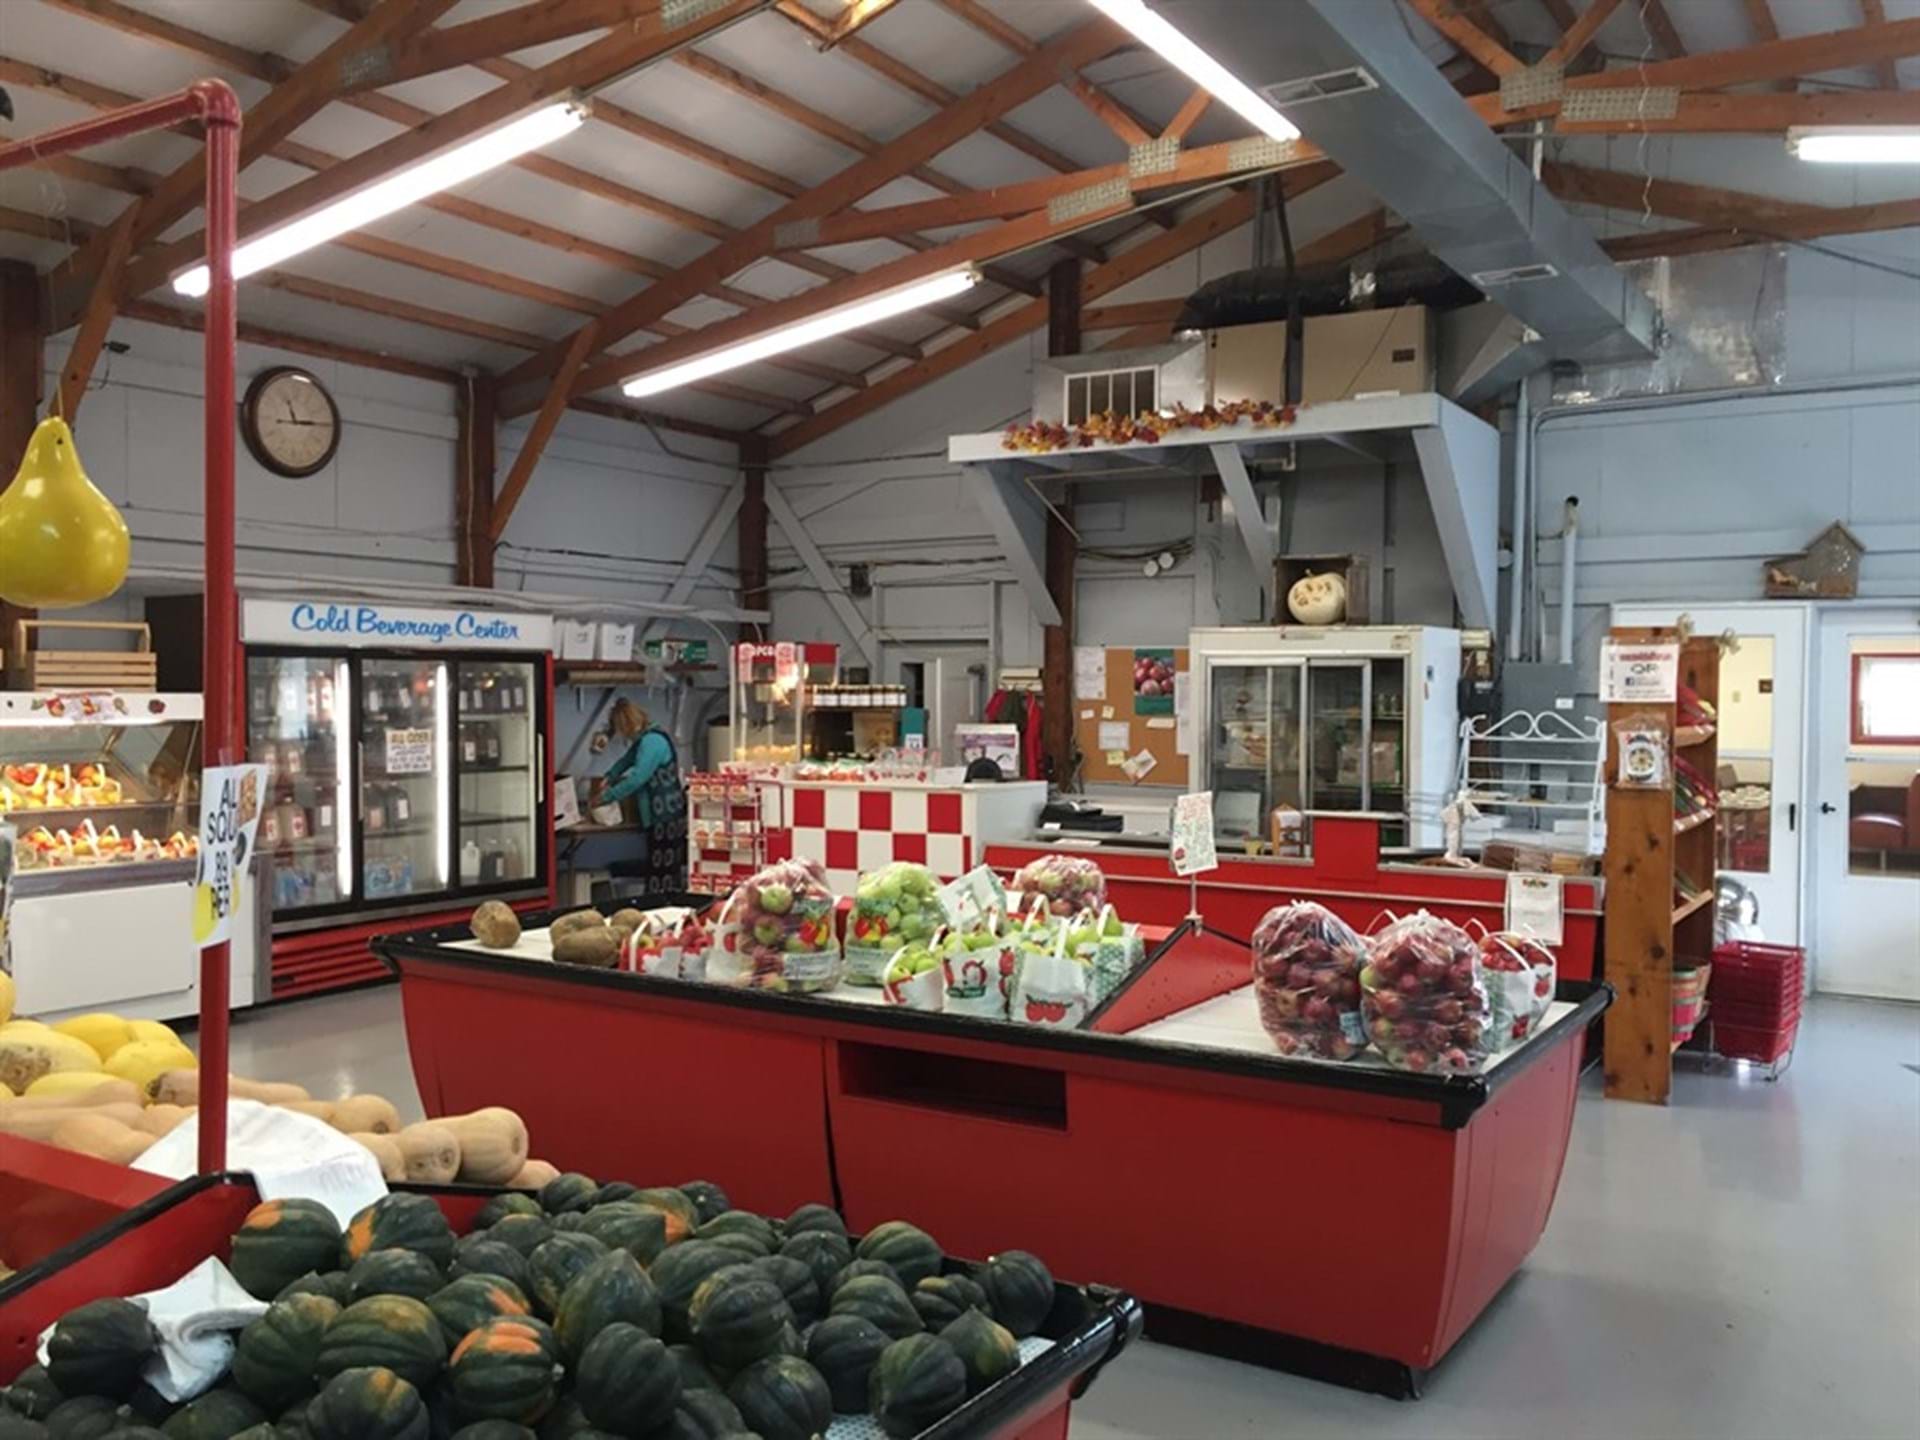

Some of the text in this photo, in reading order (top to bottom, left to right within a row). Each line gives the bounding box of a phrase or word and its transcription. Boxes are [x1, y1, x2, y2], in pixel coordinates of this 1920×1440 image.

[291, 603, 520, 643] Cold Beverage Center
